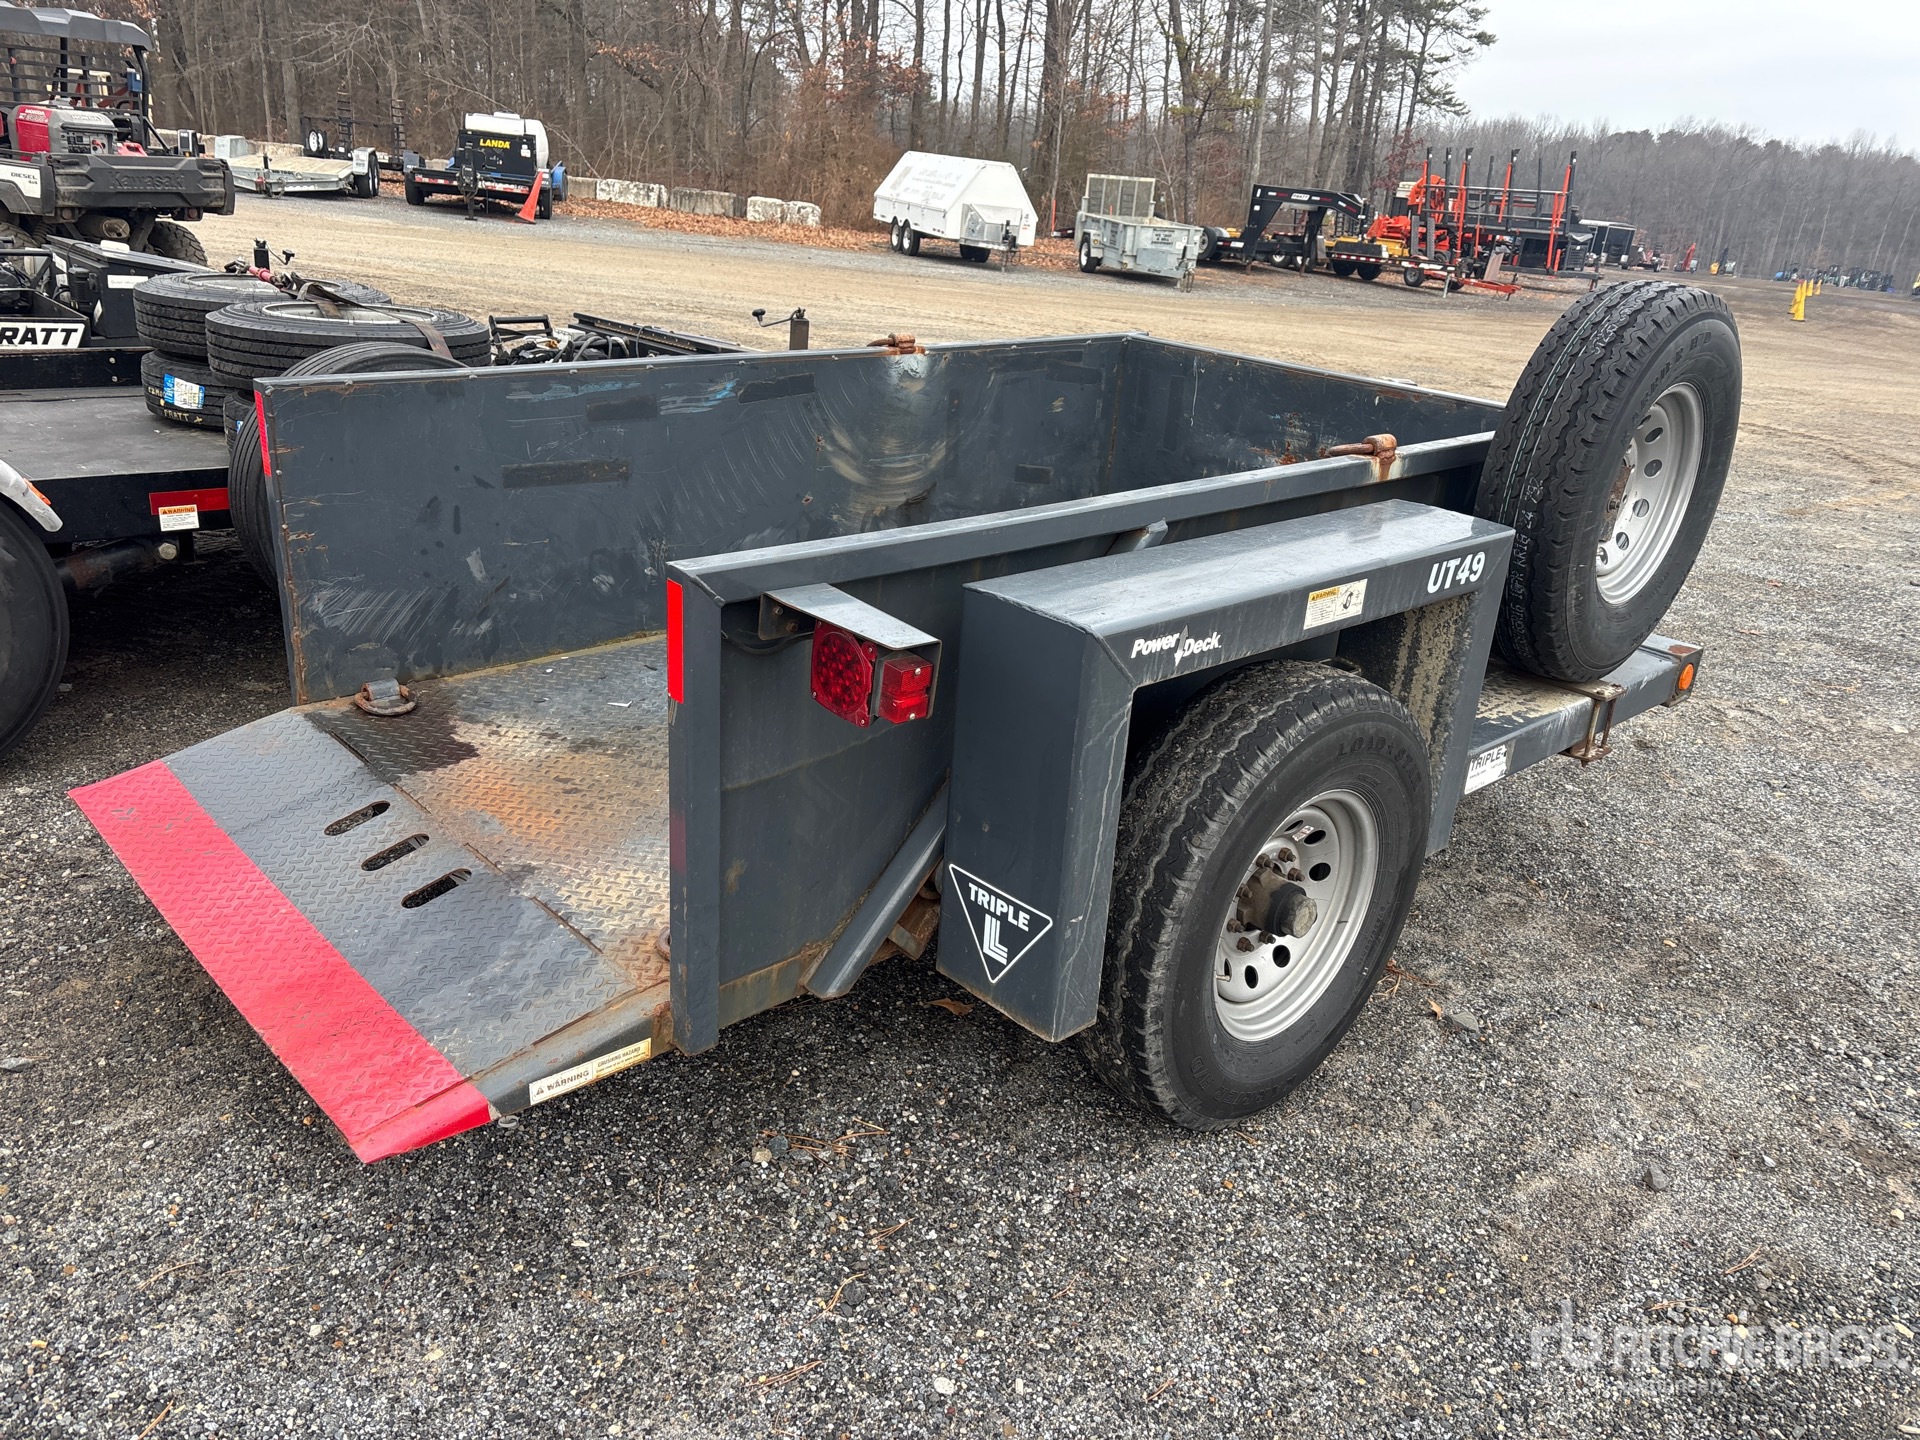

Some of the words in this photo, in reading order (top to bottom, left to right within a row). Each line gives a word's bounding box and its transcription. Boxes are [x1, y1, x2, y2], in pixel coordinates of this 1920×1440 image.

[480, 138, 511, 149] LANDA
[10, 171, 37, 180] DIESEL
[167, 507, 196, 515] WARNING
[1426, 551, 1486, 594] UT49
[1130, 632, 1180, 659] Power
[1338, 736, 1386, 758] LOAD
[968, 882, 1031, 932] TRIPLE
[546, 1069, 590, 1091] WARNING
[597, 1052, 622, 1068] CRUSHING
[621, 1046, 641, 1058] HAZARD
